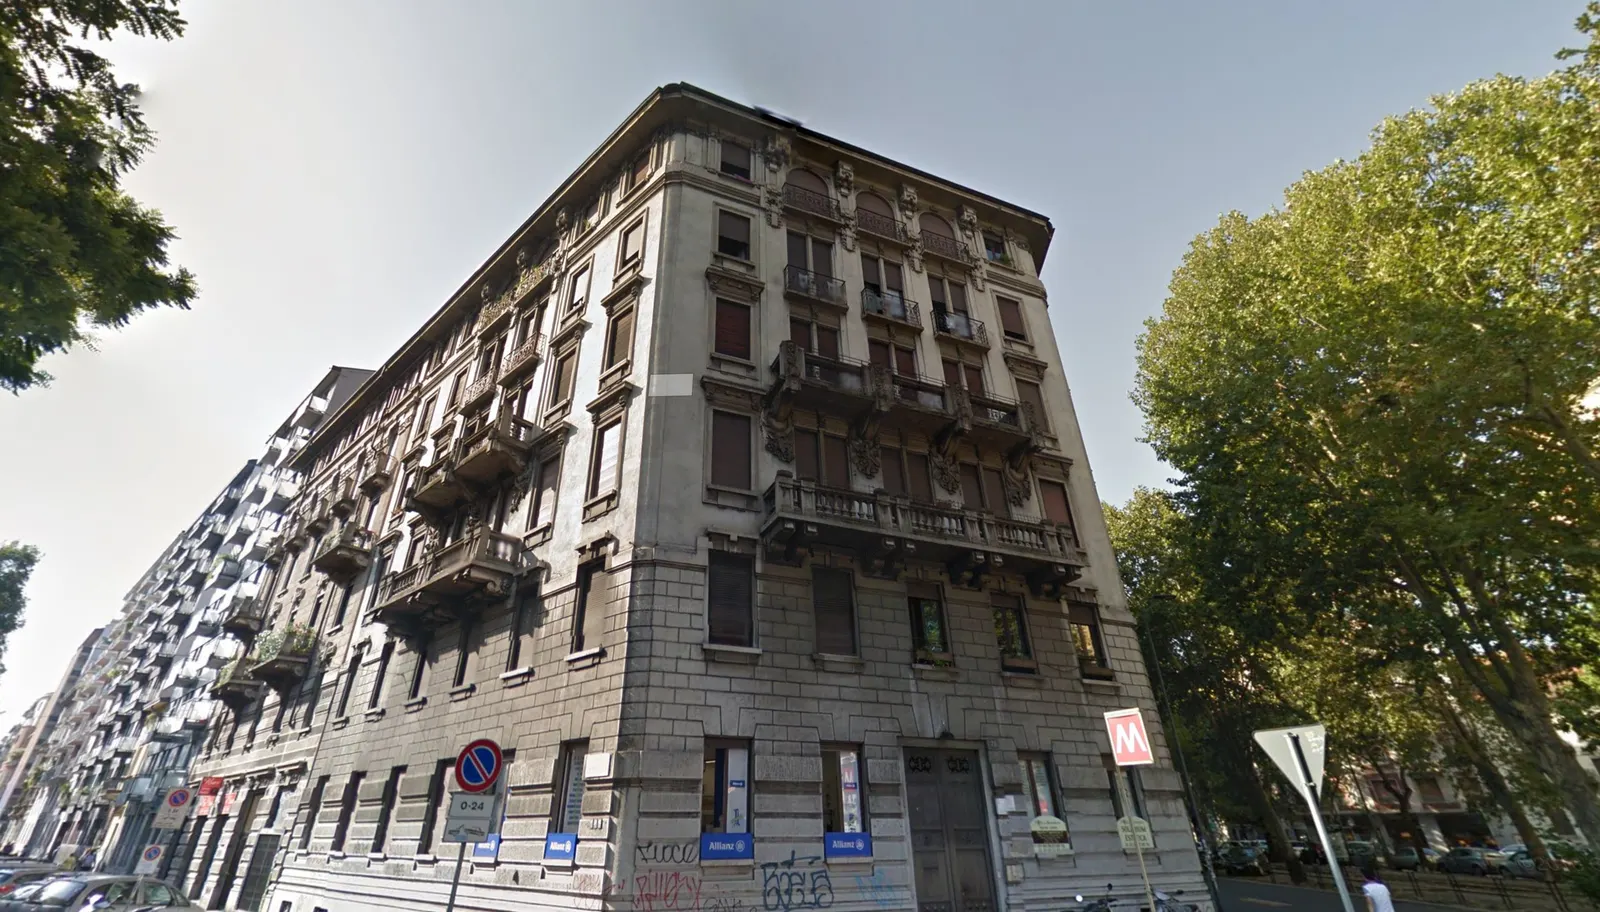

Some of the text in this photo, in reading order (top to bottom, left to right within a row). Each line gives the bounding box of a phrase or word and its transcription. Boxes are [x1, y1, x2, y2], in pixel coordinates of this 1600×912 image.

[1116, 721, 1148, 754] M
[460, 801, 484, 811] 0-24
[550, 841, 566, 851] Allianz
[709, 842, 735, 850] Allianz
[832, 840, 855, 849] Allianz
